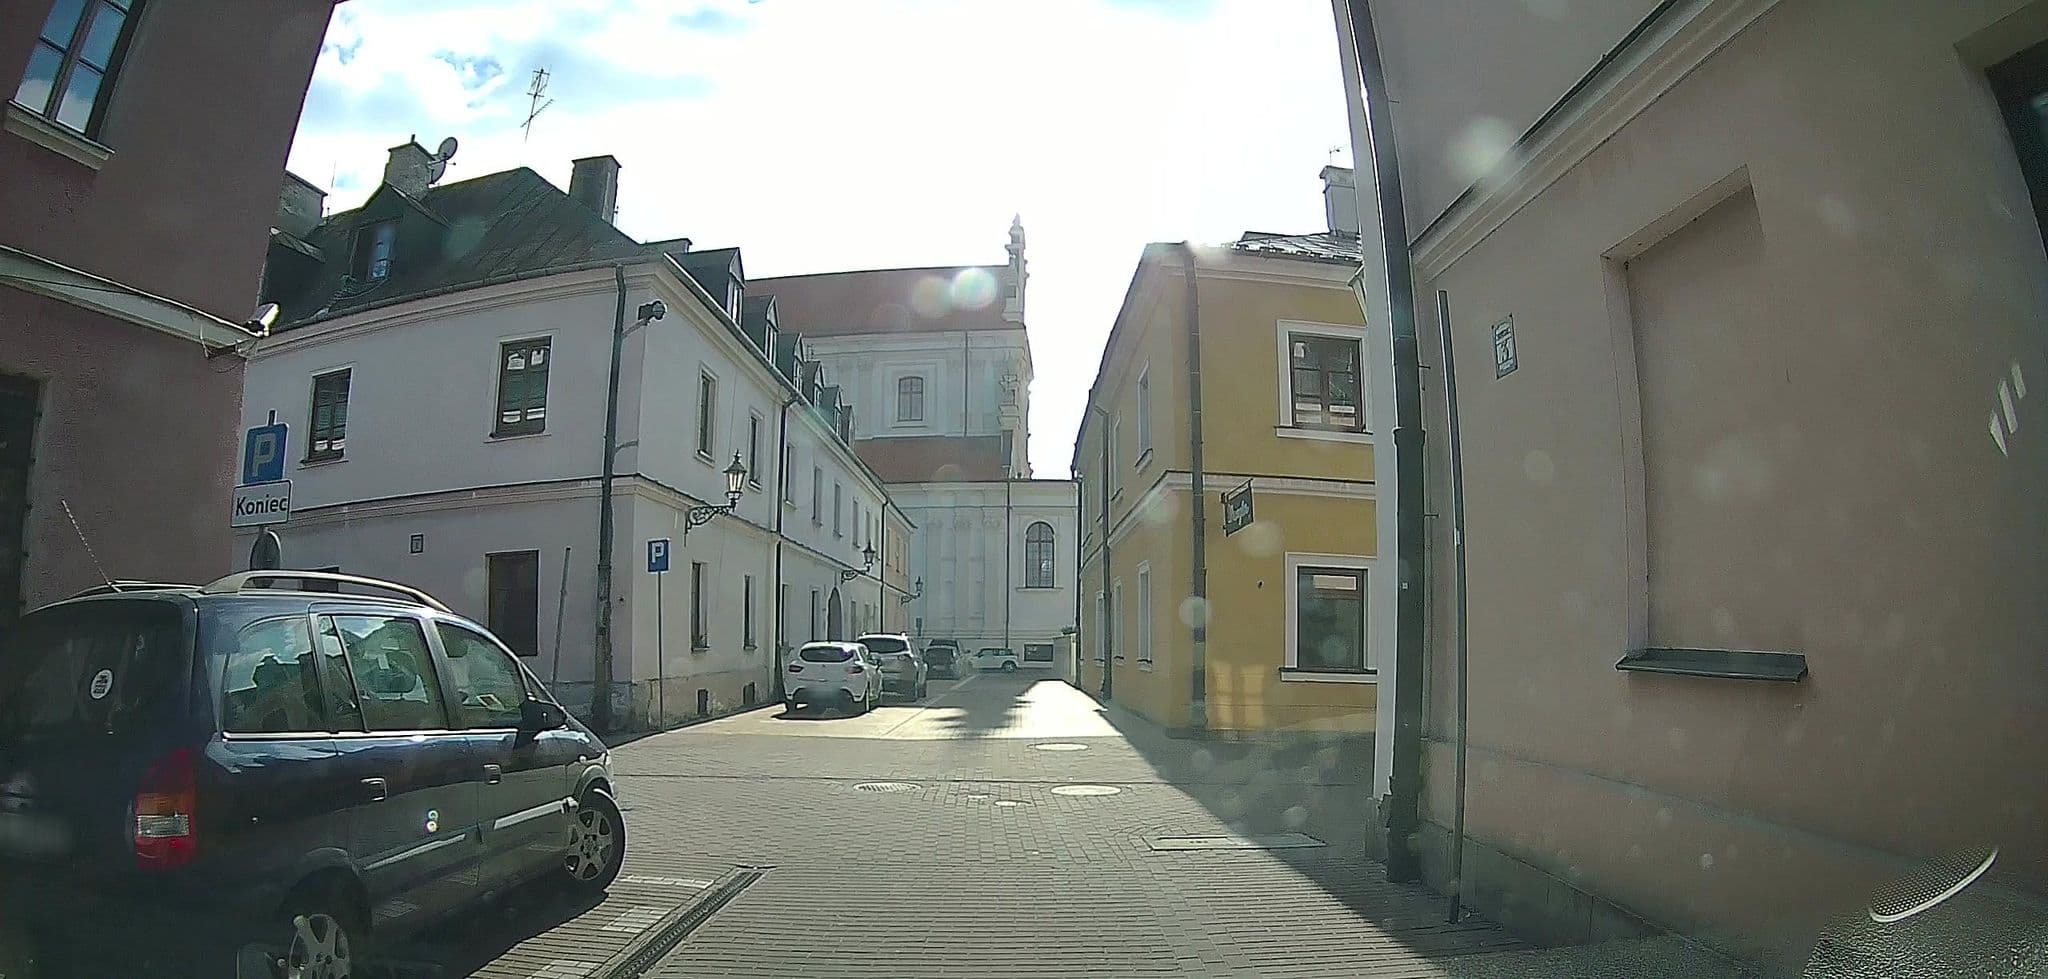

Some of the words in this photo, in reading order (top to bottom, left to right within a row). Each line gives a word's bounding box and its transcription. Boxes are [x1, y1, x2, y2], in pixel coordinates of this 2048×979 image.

[252, 433, 276, 477] P
[235, 494, 288, 516] Koniec
[651, 542, 665, 563] P
